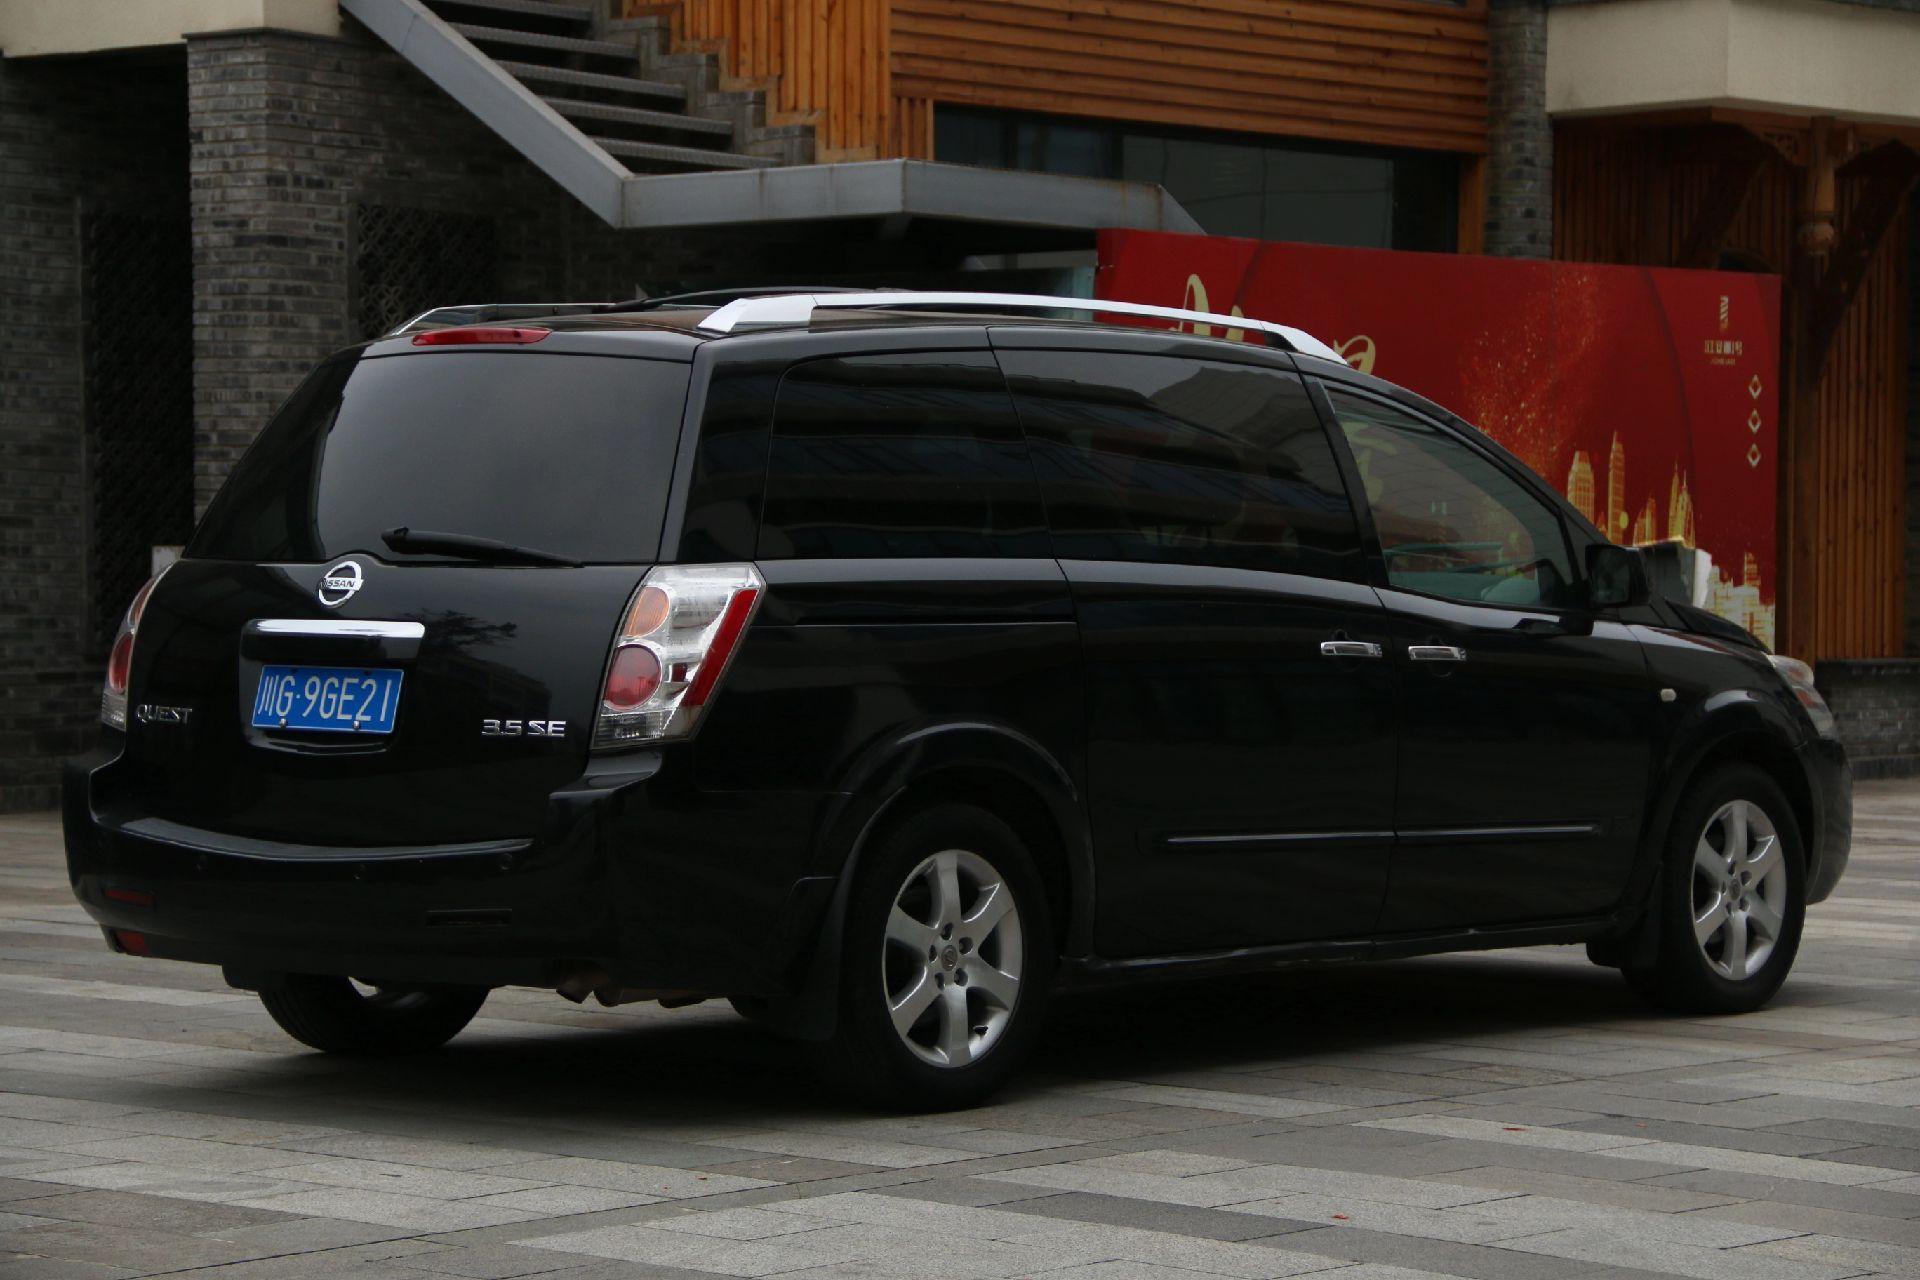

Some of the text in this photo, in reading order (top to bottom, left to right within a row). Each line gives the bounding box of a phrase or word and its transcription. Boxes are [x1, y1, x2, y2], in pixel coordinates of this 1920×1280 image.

[320, 578, 358, 589] NISSAN
[135, 704, 193, 724] QUEST
[527, 720, 567, 737] SE
